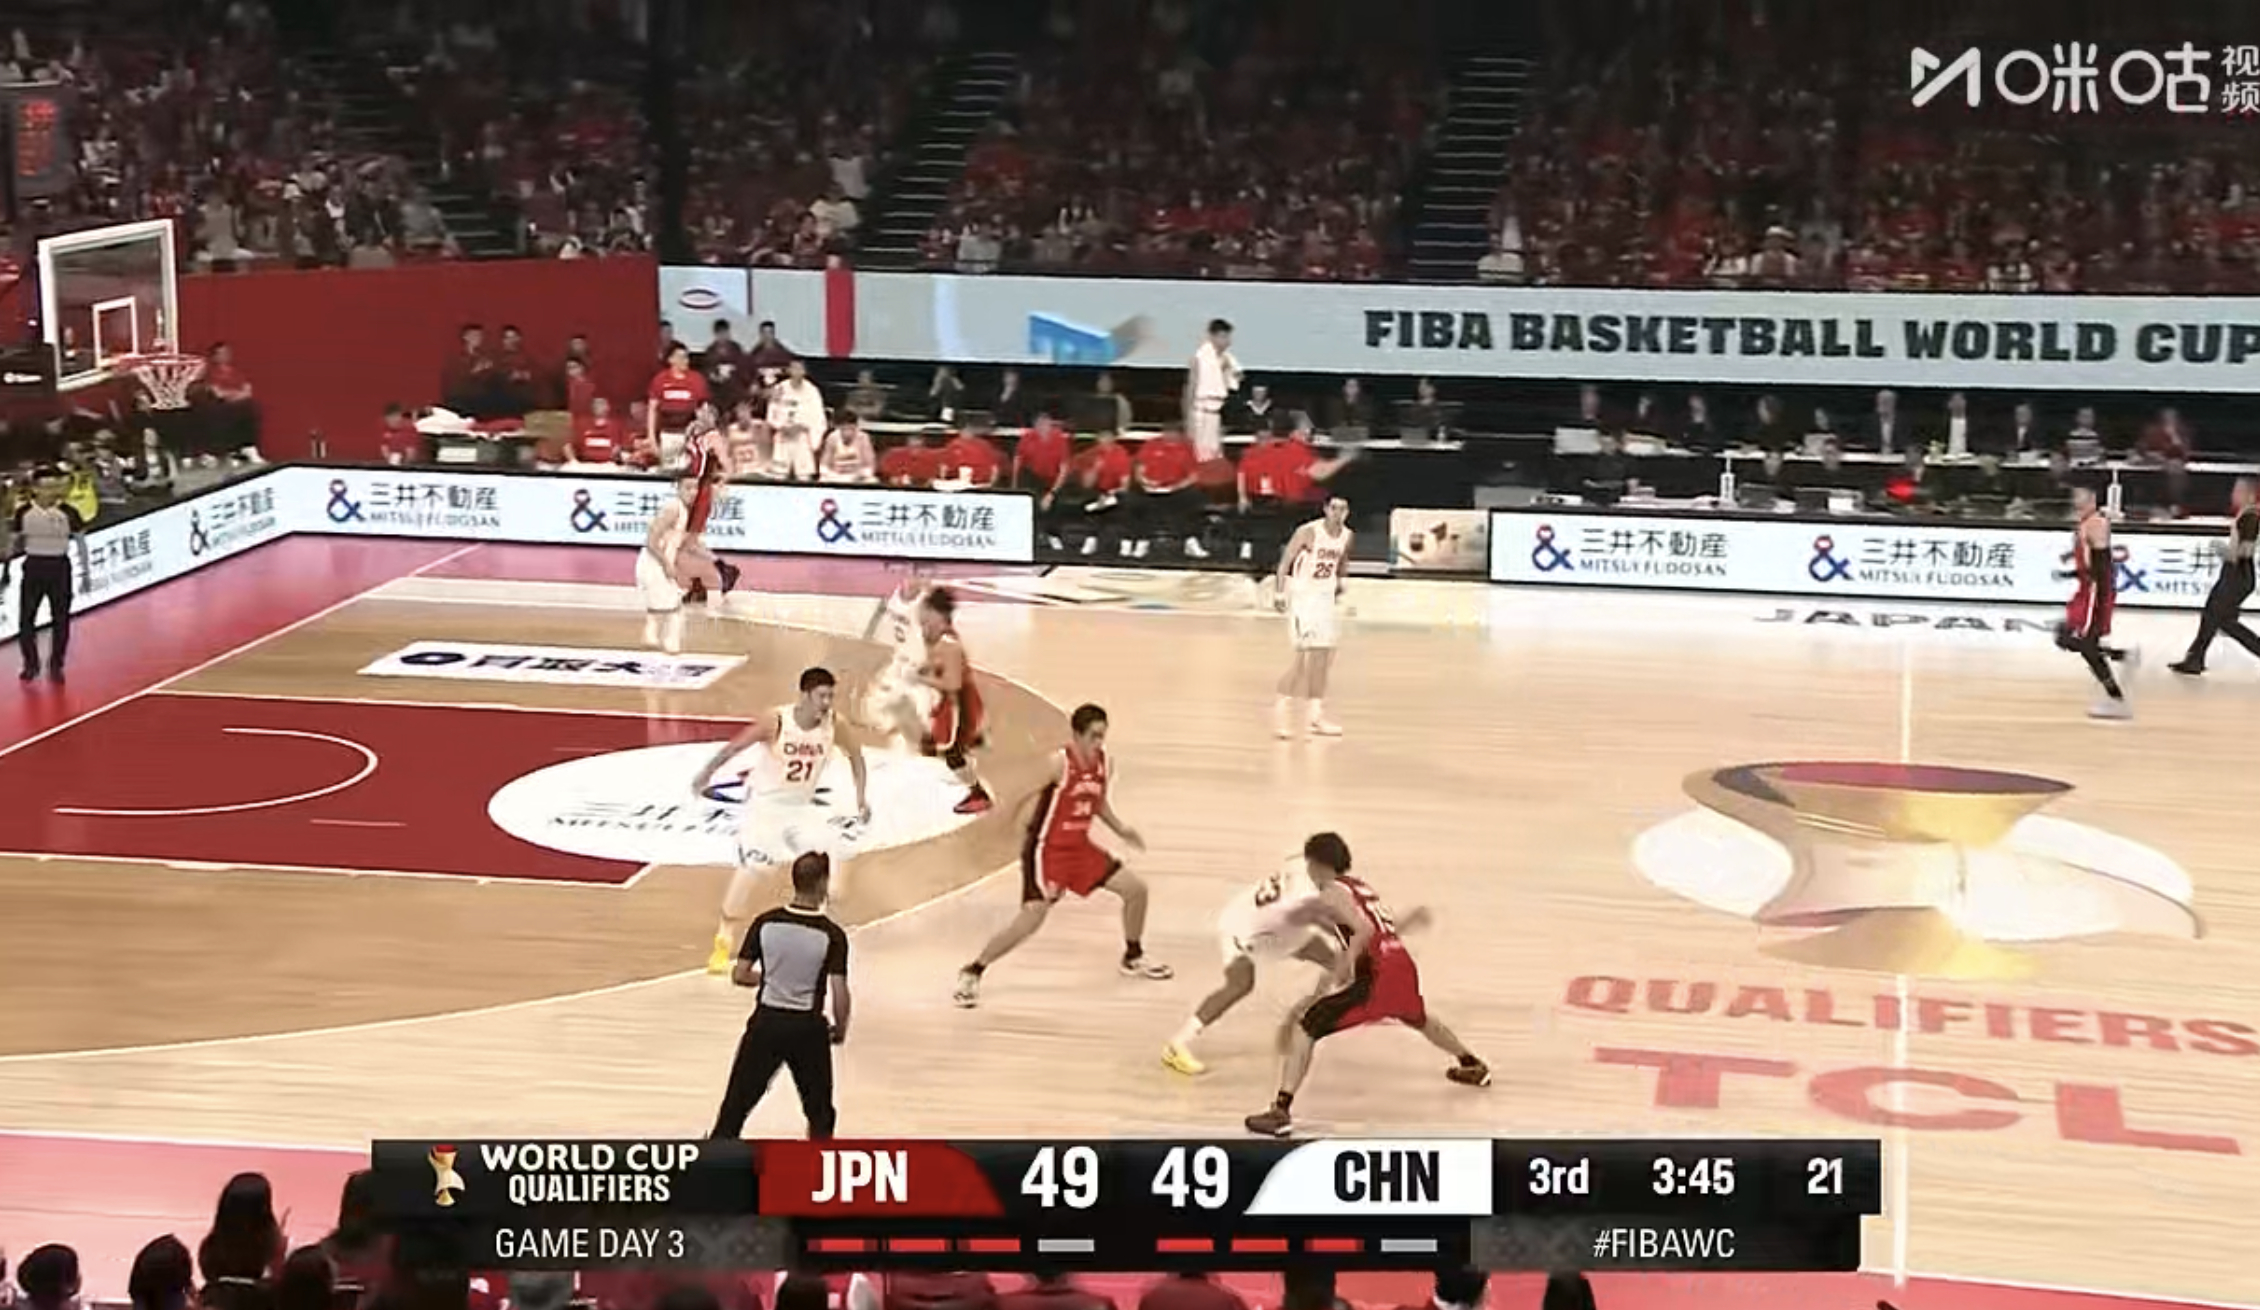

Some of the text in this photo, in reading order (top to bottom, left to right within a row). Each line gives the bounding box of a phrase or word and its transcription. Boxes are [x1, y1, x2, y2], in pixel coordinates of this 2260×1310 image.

[1364, 309, 2260, 364] FIBA BASKETBALL WORLD CUP
[369, 482, 500, 511] 三井不動産
[860, 501, 996, 531] 三井不動産
[1579, 528, 1728, 558] 三井不動産
[1859, 538, 2016, 569] 三井不動産
[1926, 571, 2014, 587] FUDOSAN
[786, 760, 813, 782] 21
[1564, 975, 2260, 1056] QUALIFIERS
[1594, 1045, 2242, 1156] TCL
